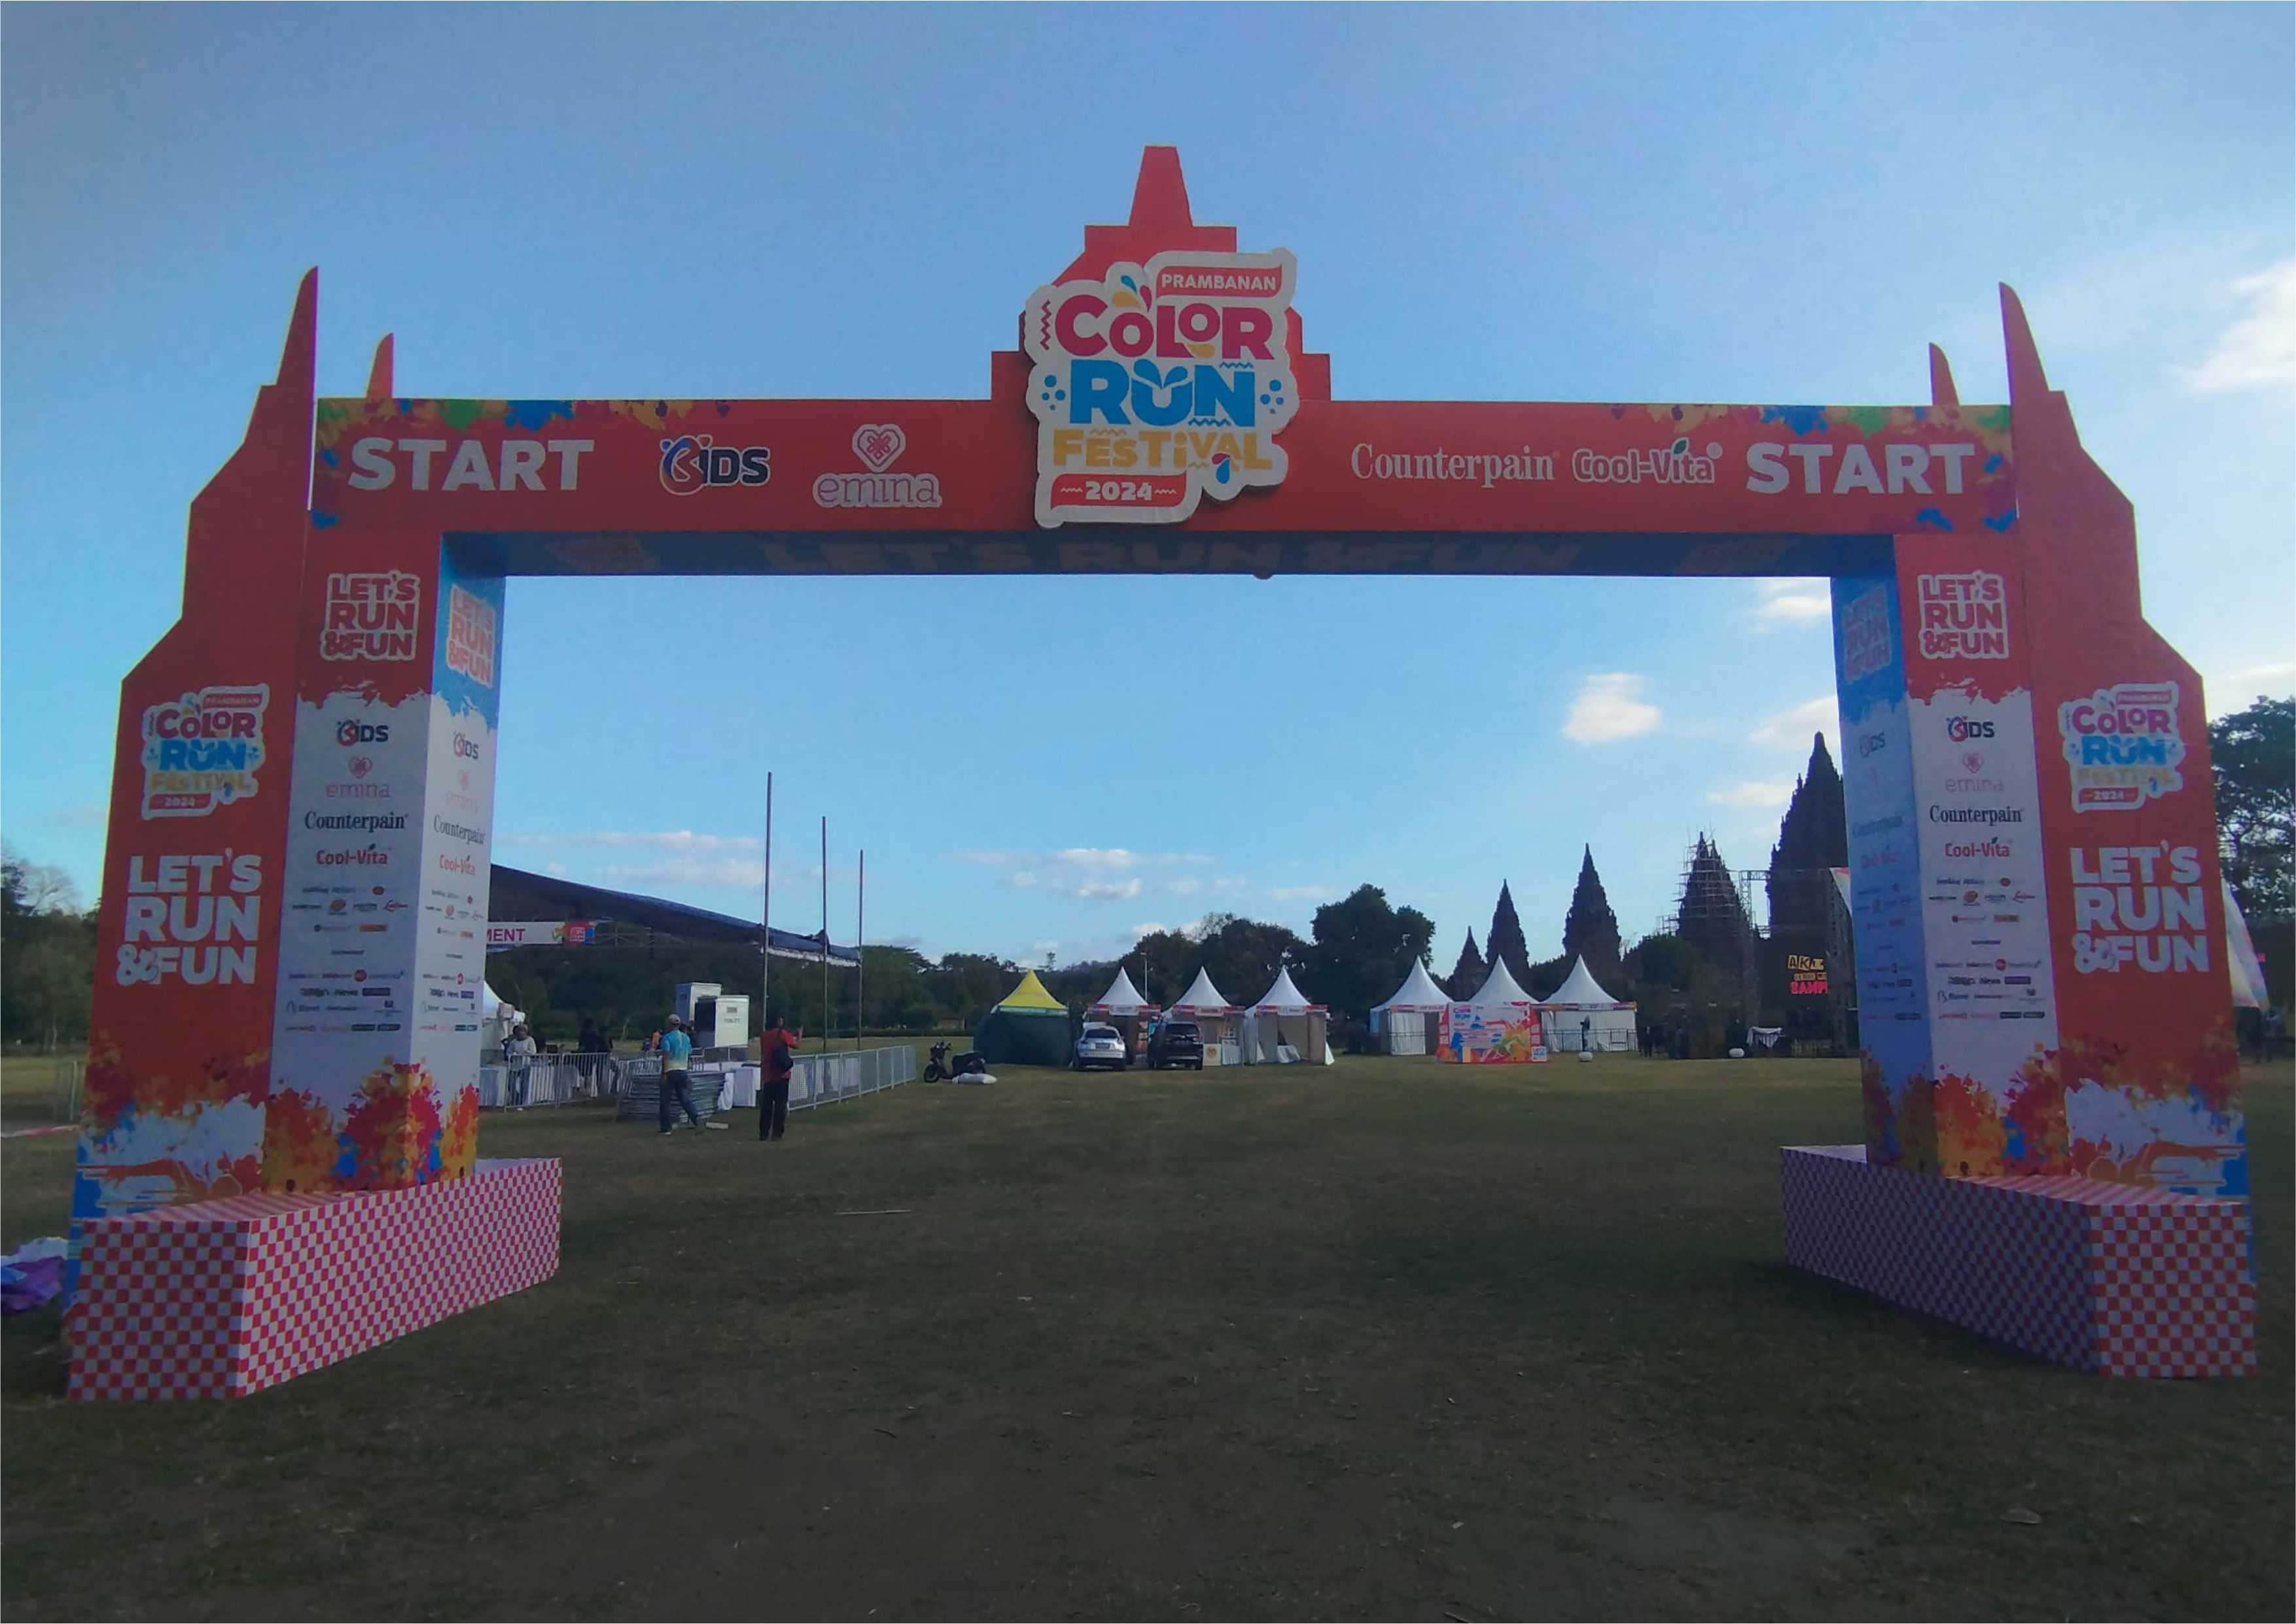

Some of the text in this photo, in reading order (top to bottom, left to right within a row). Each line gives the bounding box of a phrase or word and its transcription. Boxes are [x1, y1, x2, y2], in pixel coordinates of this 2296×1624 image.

[1161, 274, 1277, 292] PRAMBANAN
[1054, 294, 1275, 360] COLOR
[1069, 358, 1256, 427] RUN
[347, 436, 595, 491] START
[1351, 442, 1555, 489] Counterpain
[1572, 440, 1716, 484] Cool-Vita
[1746, 442, 1975, 495] START
[815, 476, 939, 504] emina
[1085, 482, 1153, 501] 2024
[330, 572, 417, 601] LET'S
[1922, 574, 2000, 601] LET'S
[329, 603, 415, 631] RUN
[1924, 603, 2004, 629] RUN
[156, 709, 256, 739] COLOR
[2072, 705, 2172, 734] COLOR
[159, 739, 246, 771] RUN
[2081, 735, 2166, 765] RUN
[304, 811, 406, 833] Counterpain
[1930, 805, 2022, 826] Counterpain
[316, 844, 387, 865] Cool-Vita
[1944, 837, 2010, 858] Cool-Vita
[2070, 839, 2201, 883] LET'S
[128, 847, 262, 893] LET'S
[124, 894, 261, 942] RUN
[2074, 886, 2206, 931] RUN
[115, 943, 257, 987] &FUN
[2072, 932, 2210, 974] &FUN
